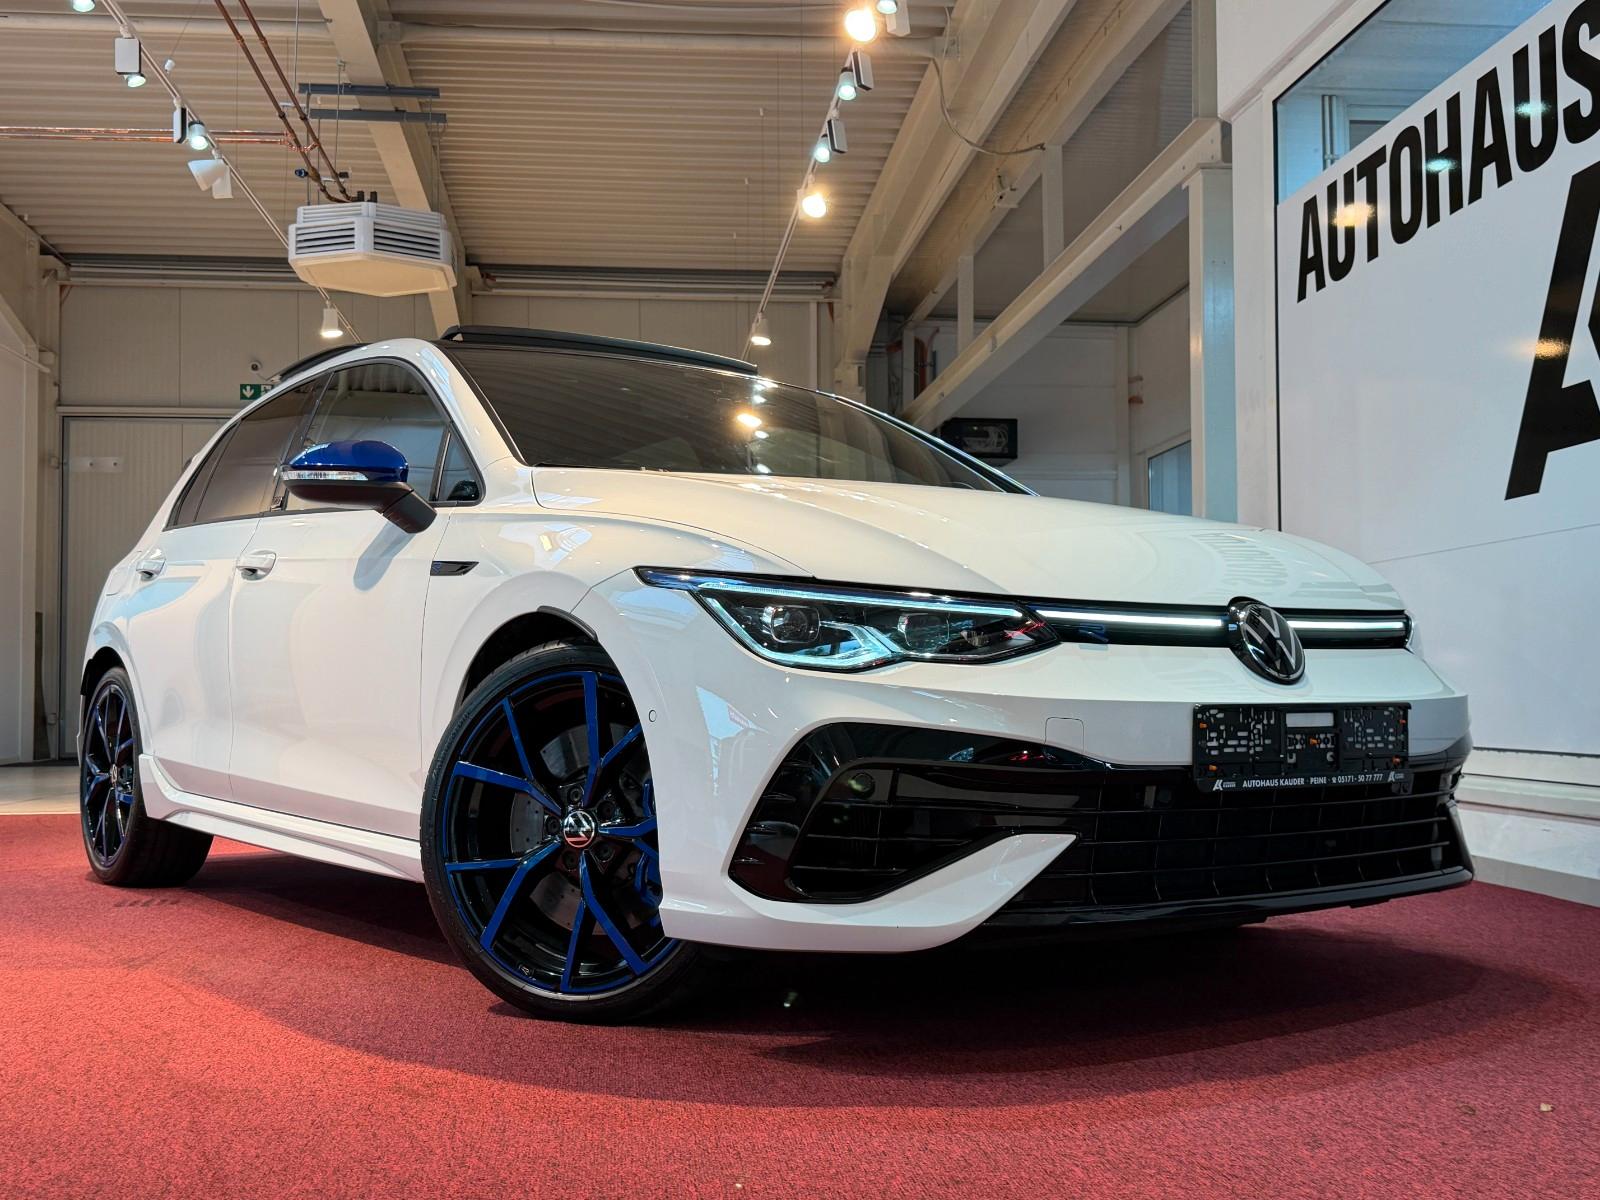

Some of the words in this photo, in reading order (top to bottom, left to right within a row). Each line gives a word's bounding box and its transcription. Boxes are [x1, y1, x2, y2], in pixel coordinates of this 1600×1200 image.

[1297, 0, 1600, 303] AUTOHAUS
[1242, 779, 1279, 788] AUTOHAUS
[1279, 777, 1305, 786] KAUDER
[1310, 776, 1327, 785] PEINE
[1365, 773, 1373, 782] 77
[1373, 773, 1384, 782] 777
